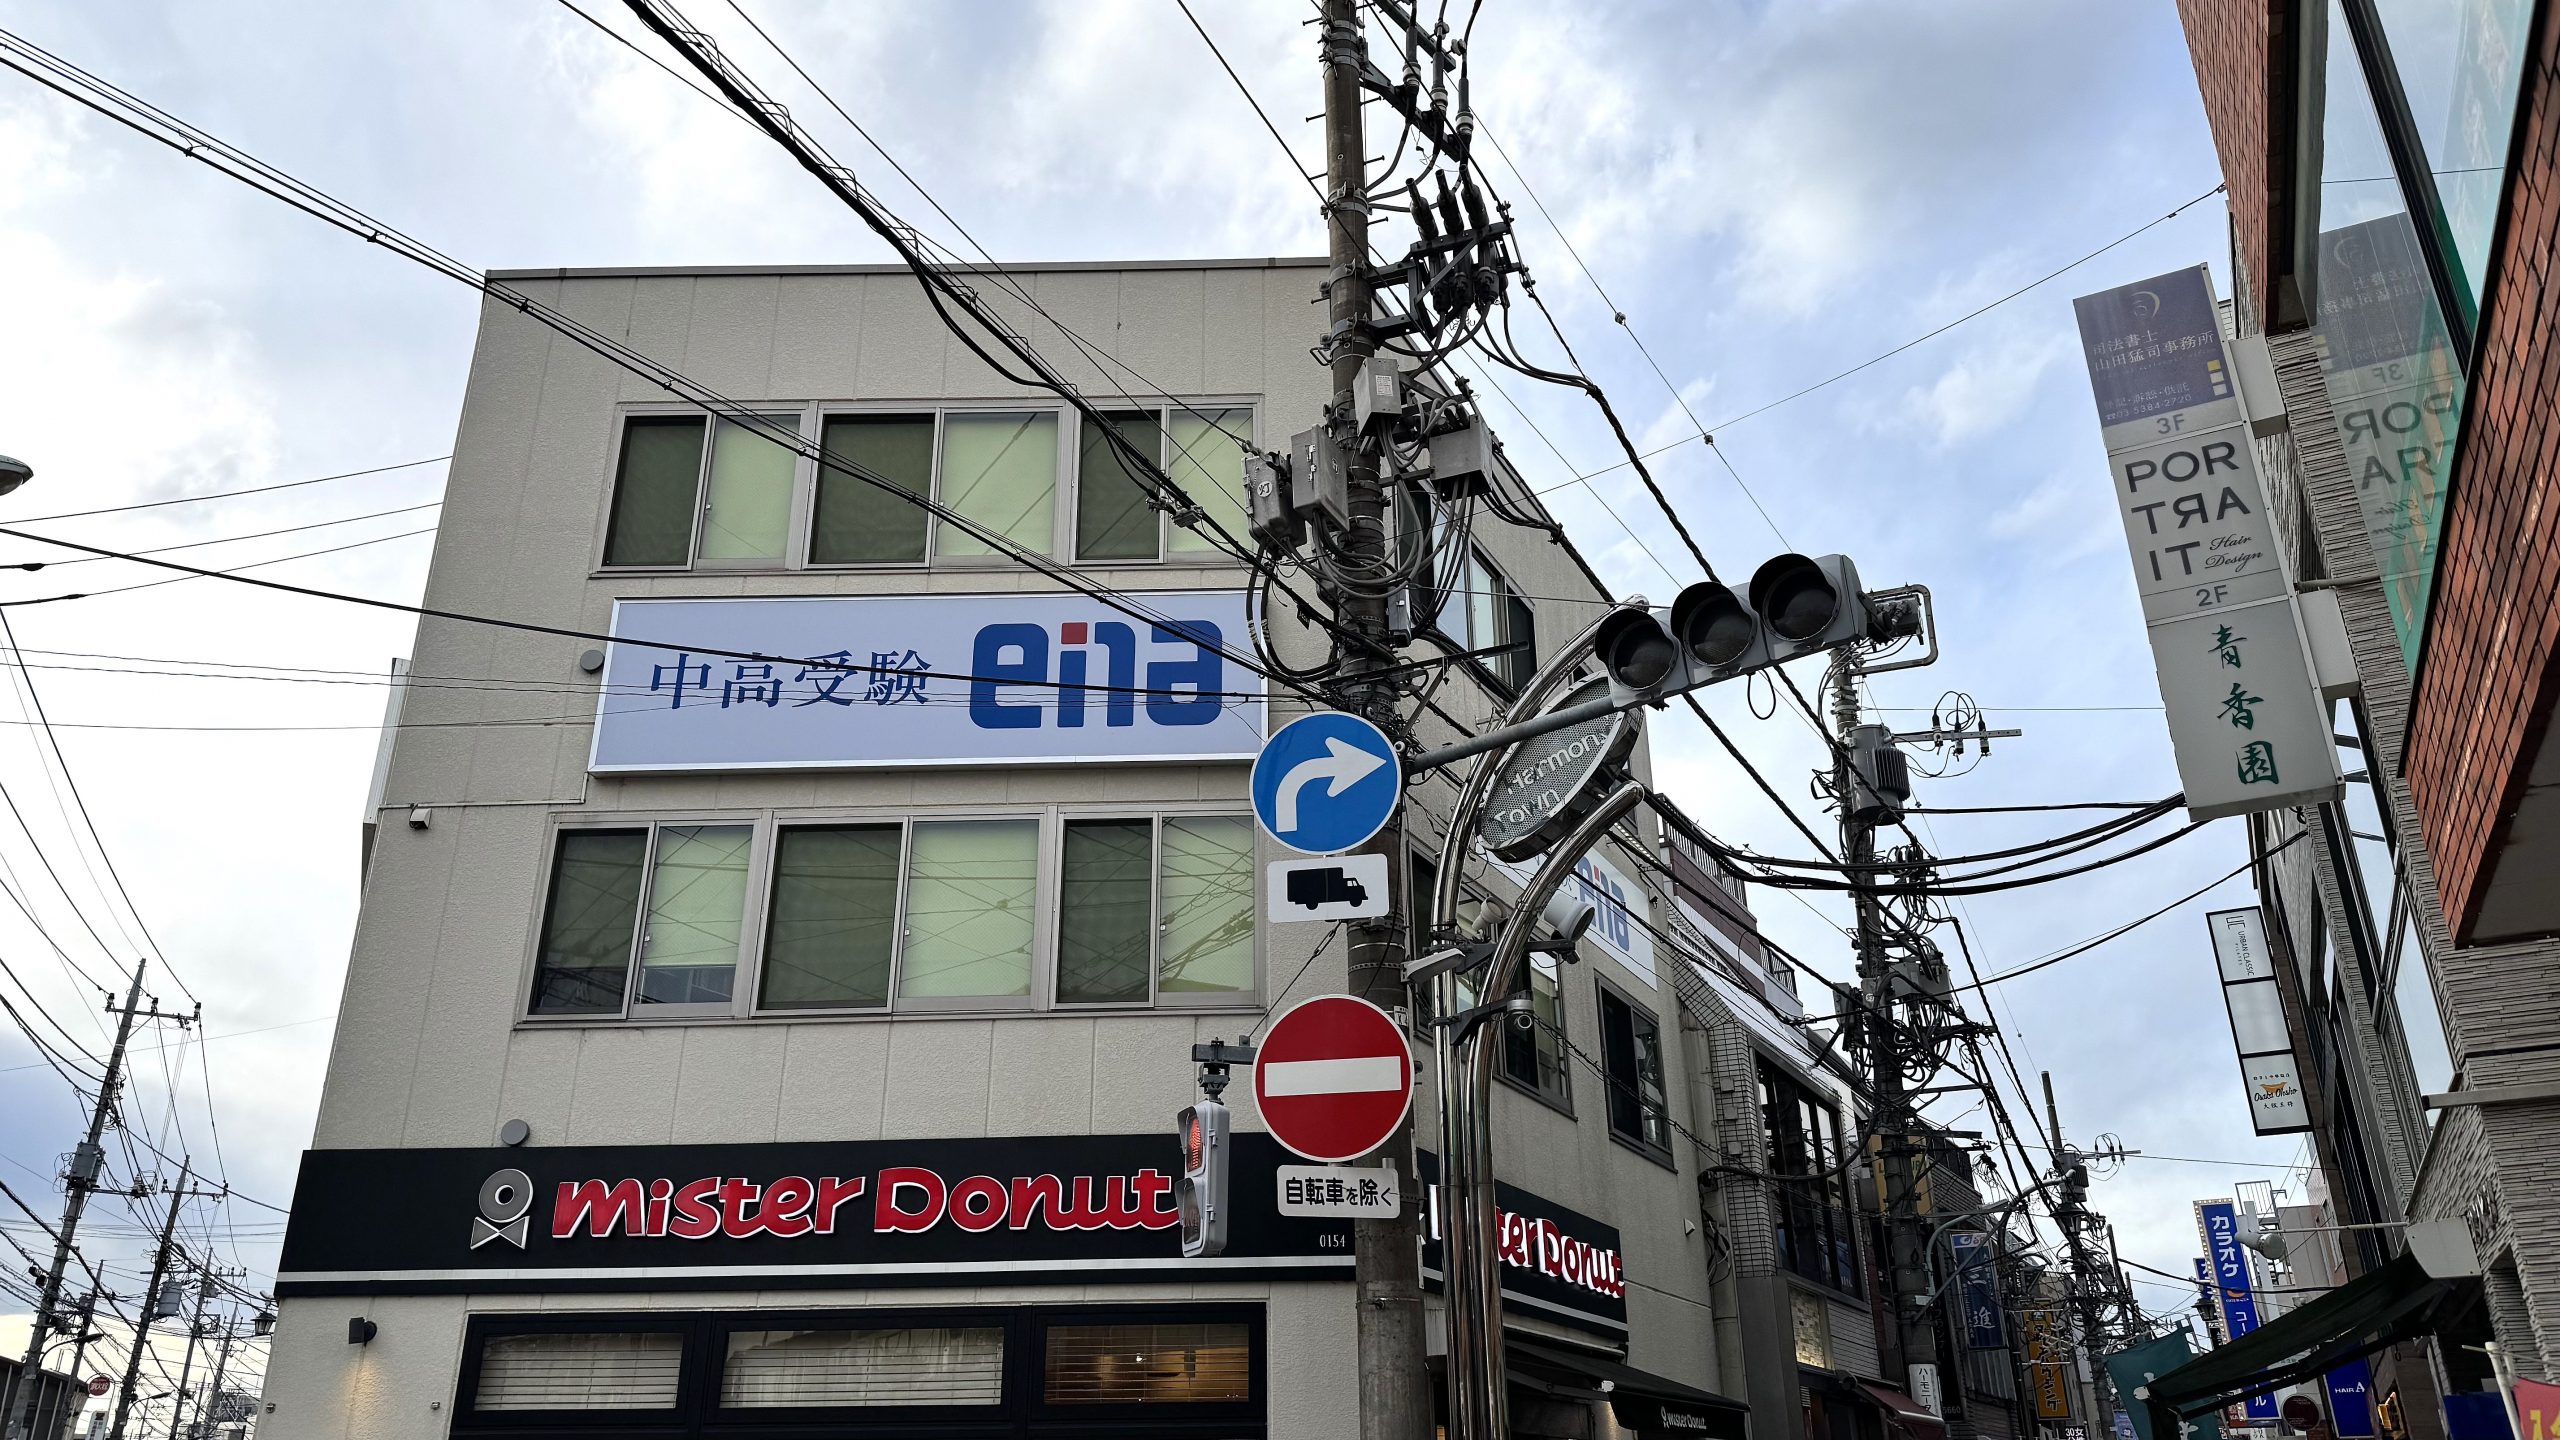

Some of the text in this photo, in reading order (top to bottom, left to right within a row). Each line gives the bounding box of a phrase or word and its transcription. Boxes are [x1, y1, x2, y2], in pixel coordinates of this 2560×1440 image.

[2093, 329, 2159, 355] 司法書士
[2157, 413, 2185, 434] 3F
[2125, 441, 2239, 493] POR
[2210, 533, 2252, 551] Hair
[2149, 541, 2200, 581] IT
[2204, 551, 2264, 573] Design
[2196, 584, 2228, 607] 2F
[651, 620, 1222, 729] 中高受験 ena
[874, 1167, 1182, 1234] Donut
[1286, 1176, 1392, 1207] 自転車を除く
[1319, 1234, 1346, 1248] 0154
[2211, 1215, 2239, 1278] カラオケ
[1535, 1217, 1625, 1299] Donut
[2355, 1381, 2366, 1393] A
